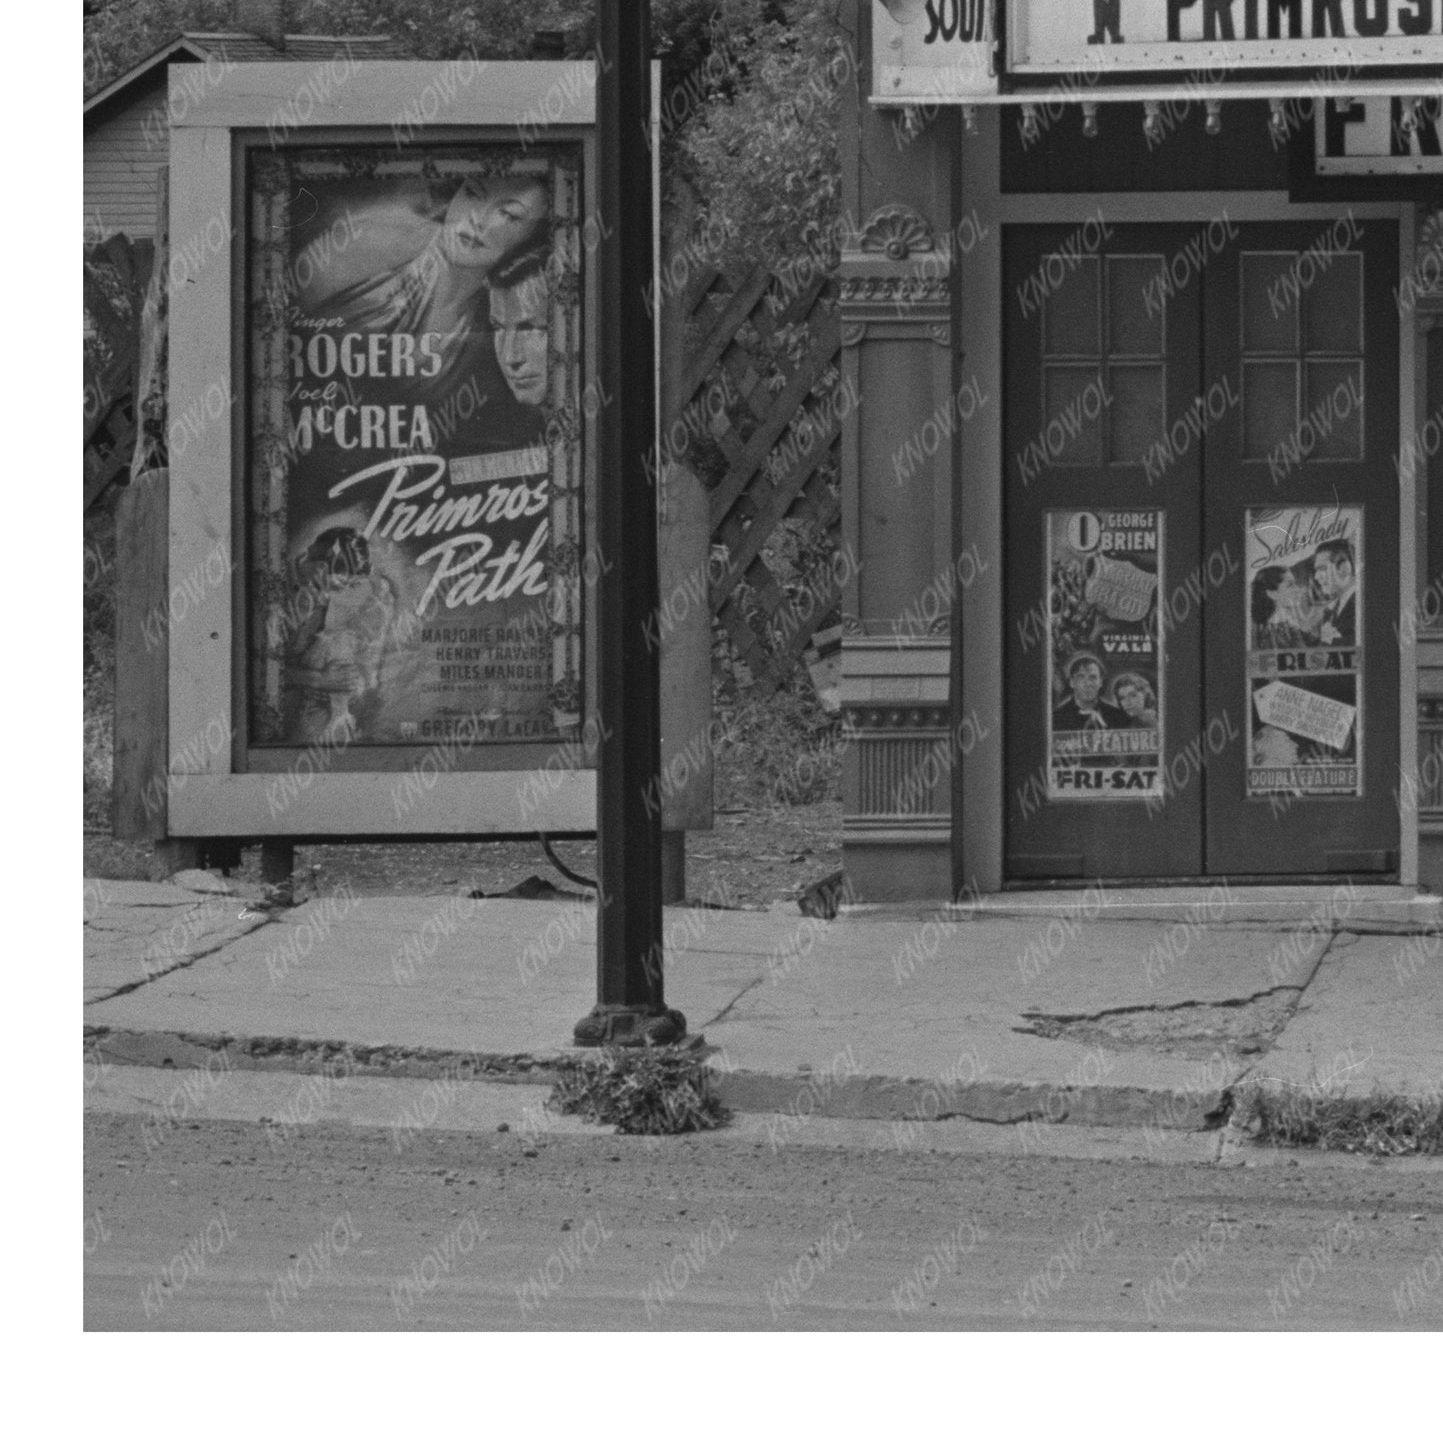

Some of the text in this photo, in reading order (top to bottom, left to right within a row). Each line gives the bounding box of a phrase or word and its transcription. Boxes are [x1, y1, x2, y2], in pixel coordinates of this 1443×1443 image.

[329, 455, 549, 542] Primros
[1108, 512, 1155, 528] GEORGE
[416, 519, 549, 617] Path
[1093, 730, 1158, 753] FEATURE
[1056, 770, 1157, 789] FRI-SAT
